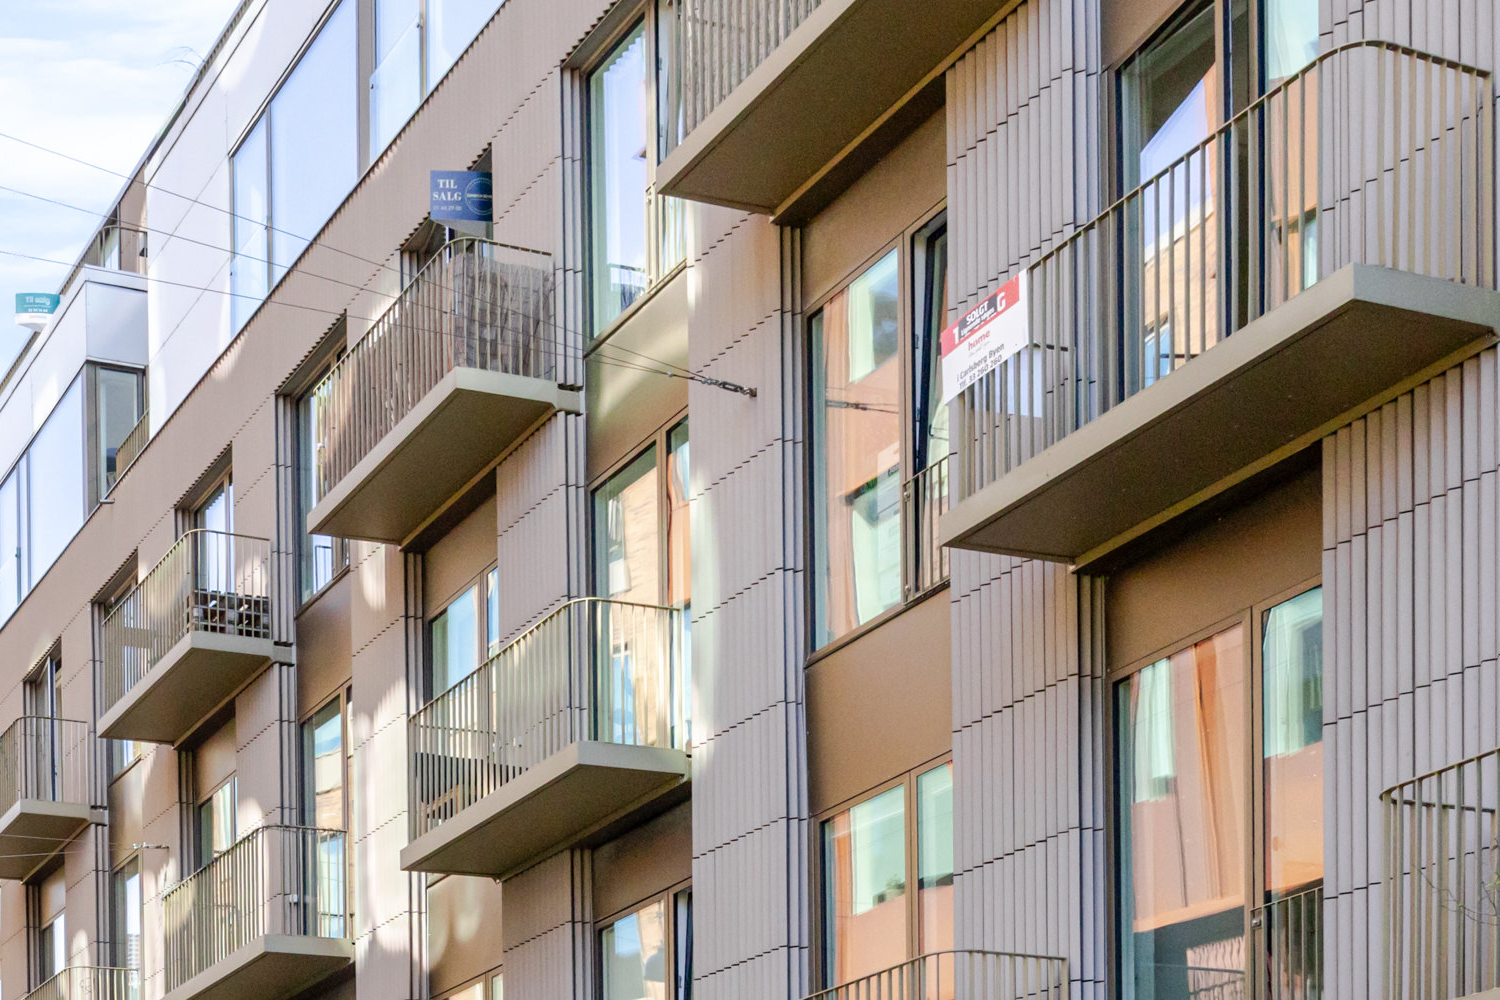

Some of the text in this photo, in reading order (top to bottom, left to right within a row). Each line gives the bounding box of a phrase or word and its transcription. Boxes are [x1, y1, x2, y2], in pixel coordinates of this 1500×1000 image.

[437, 179, 458, 189] TIL
[432, 191, 462, 201] SALG
[966, 301, 989, 325] SOLGT
[968, 330, 991, 351] home
[960, 355, 988, 380] Carlsberg
[988, 343, 1005, 359] Byen
